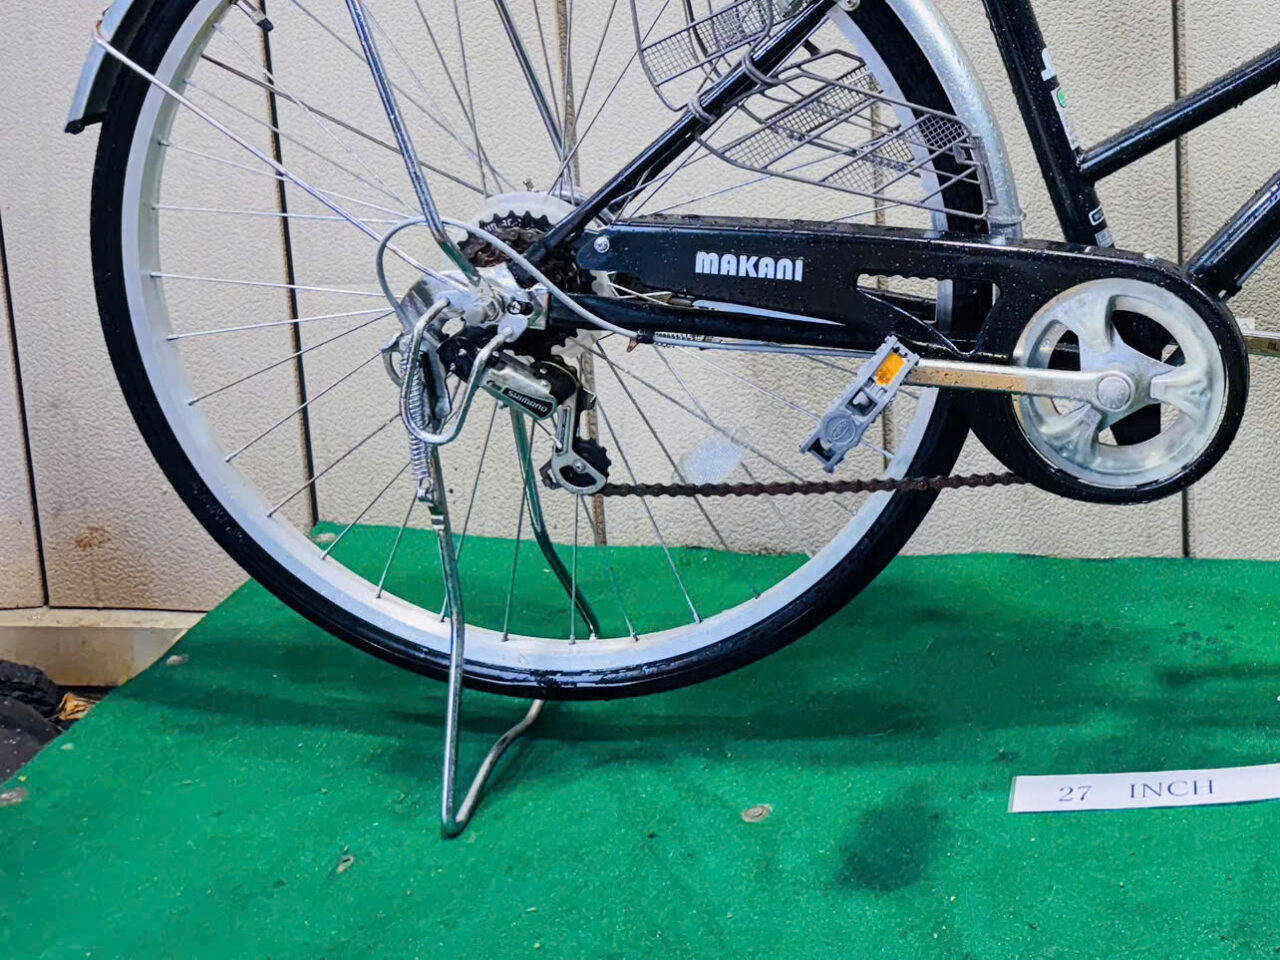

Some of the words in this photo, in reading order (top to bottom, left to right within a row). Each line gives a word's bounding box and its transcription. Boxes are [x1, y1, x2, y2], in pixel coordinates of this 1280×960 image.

[695, 251, 804, 282] MAKANI
[1057, 785, 1093, 802] 27
[1130, 779, 1214, 799] INCH
